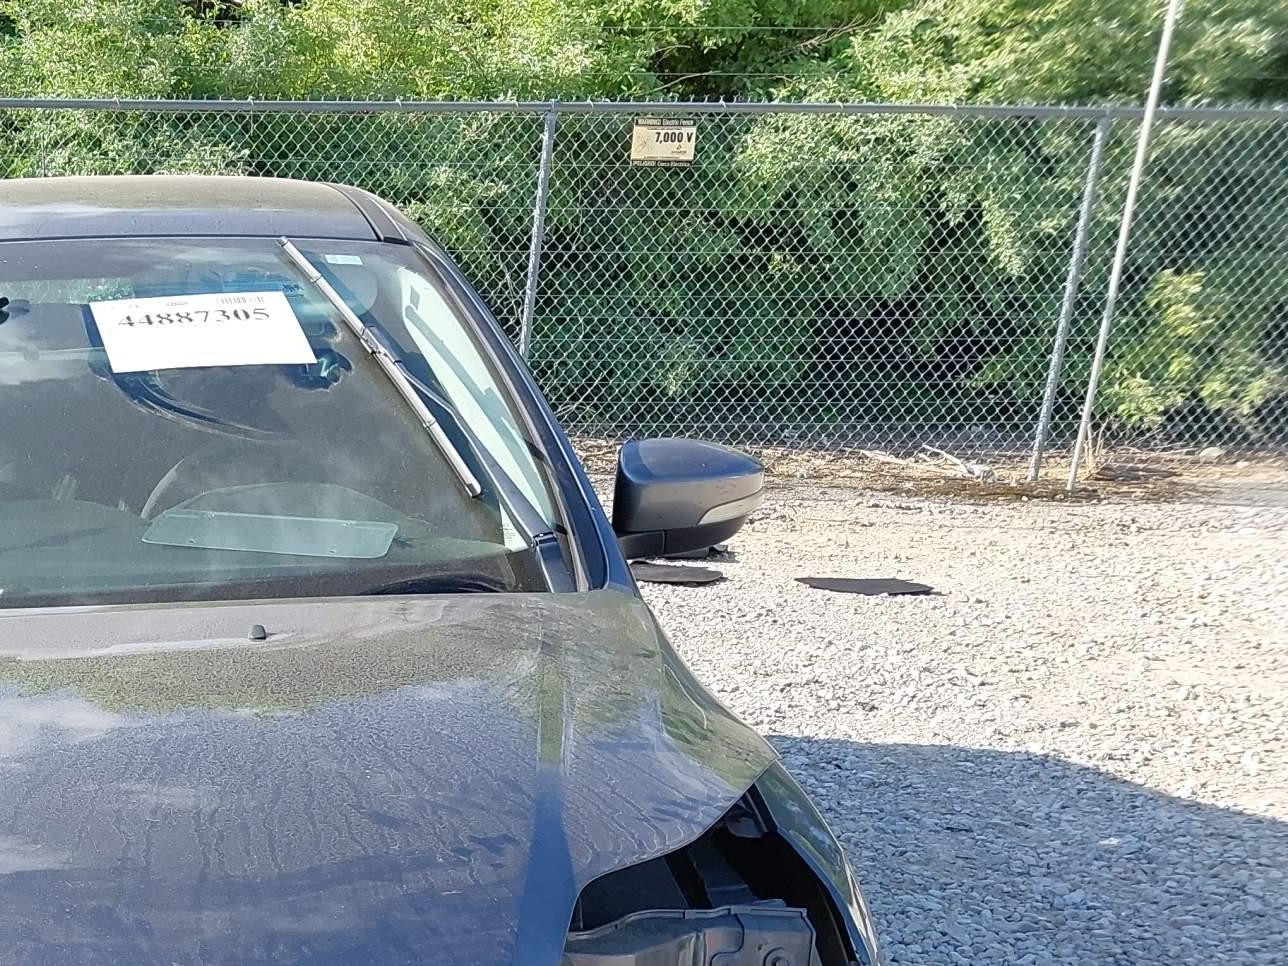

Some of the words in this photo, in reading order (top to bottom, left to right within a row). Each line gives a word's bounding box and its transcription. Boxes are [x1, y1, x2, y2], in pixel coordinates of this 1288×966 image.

[655, 132, 683, 144] 7,000
[686, 132, 693, 143] V
[118, 307, 270, 327] 44887305
